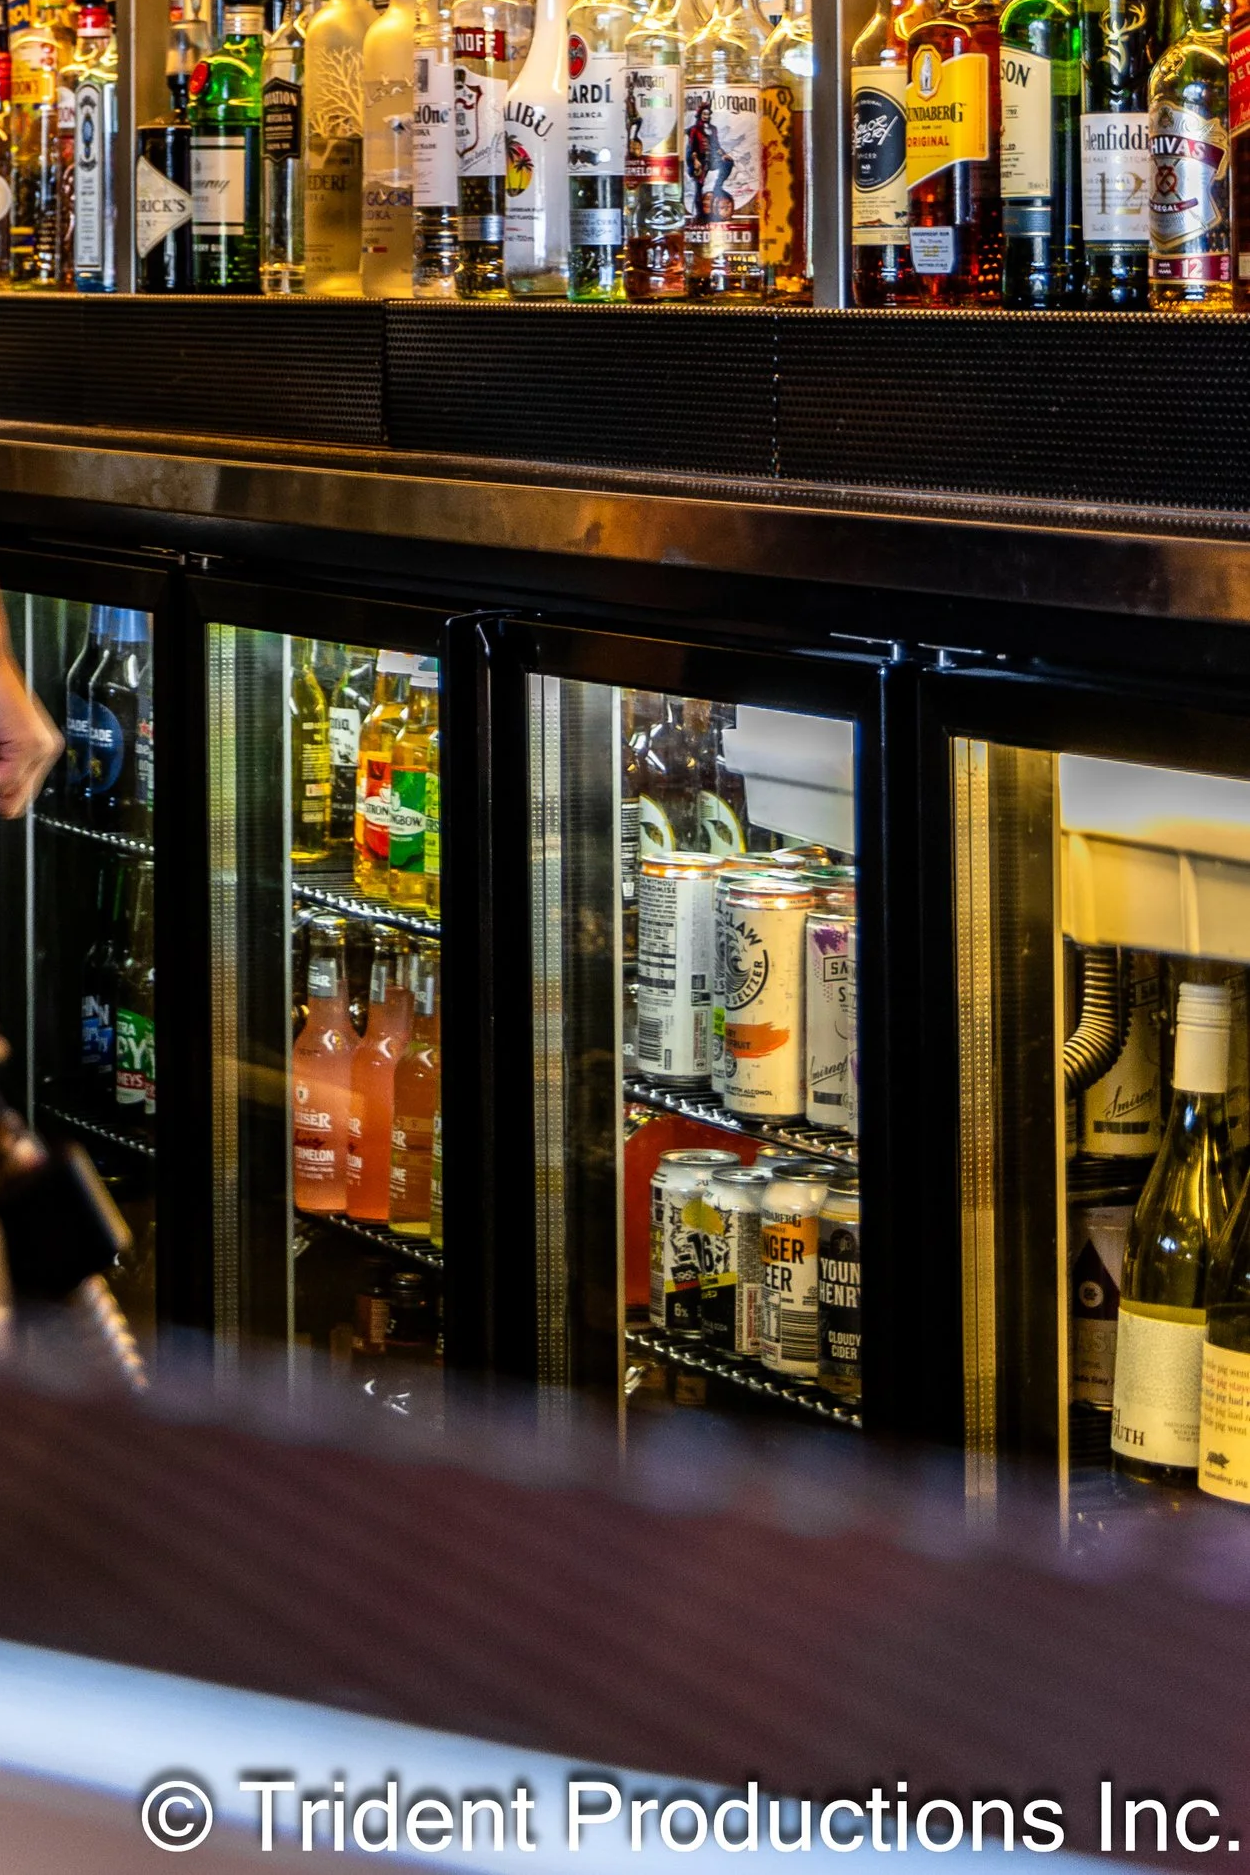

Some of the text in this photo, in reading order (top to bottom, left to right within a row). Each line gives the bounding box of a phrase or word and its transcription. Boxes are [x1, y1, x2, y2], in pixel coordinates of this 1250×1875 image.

[704, 89, 756, 115] Morgan
[504, 100, 554, 141] LIBU
[907, 135, 950, 148] ORIGINAL
[1083, 124, 1150, 152] Glenfiddi
[1150, 135, 1206, 158] HIVAS
[1096, 171, 1145, 216] 12
[1181, 258, 1204, 279] 12
[365, 802, 389, 816] STRON
[391, 814, 423, 826] NGBOW
[733, 959, 764, 1006] SELTZER
[764, 1264, 793, 1293] EER
[820, 1257, 861, 1284] YOUN
[828, 1330, 862, 1347] CLOUDY
[831, 1345, 858, 1360] CIDER
